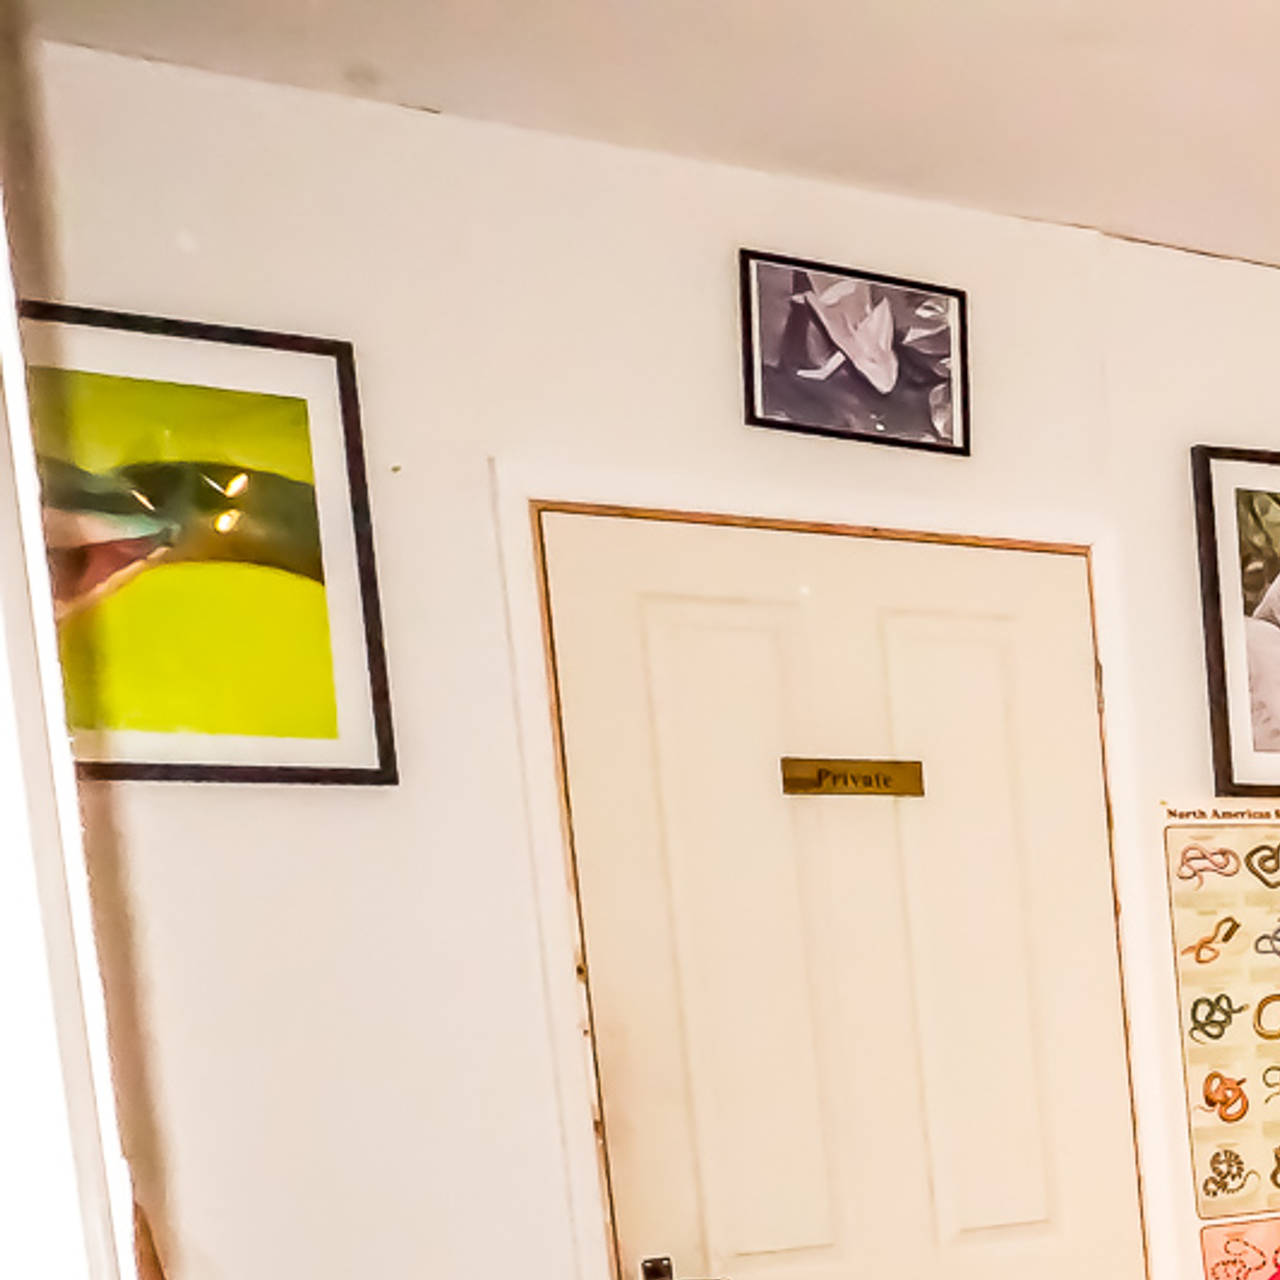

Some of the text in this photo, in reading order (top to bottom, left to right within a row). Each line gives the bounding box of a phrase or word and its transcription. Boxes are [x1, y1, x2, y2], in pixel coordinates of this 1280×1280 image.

[817, 768, 892, 788] Private
[1167, 808, 1206, 819] North
[1211, 808, 1271, 819] American
